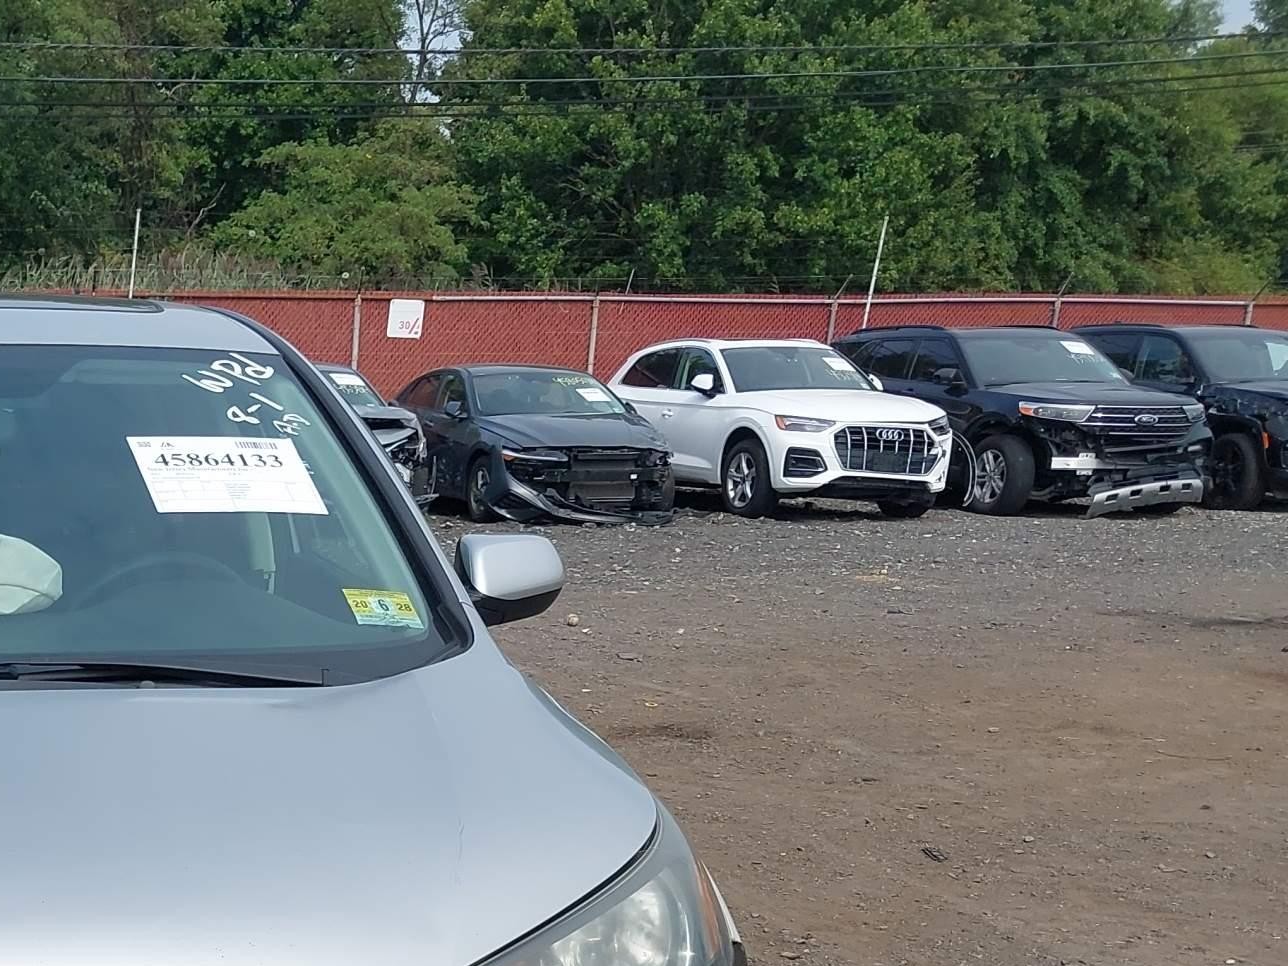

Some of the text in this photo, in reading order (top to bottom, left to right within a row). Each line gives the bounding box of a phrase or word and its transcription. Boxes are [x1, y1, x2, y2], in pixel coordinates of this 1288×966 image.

[154, 453, 283, 468] 45864133
[352, 599, 412, 612] 20 6 28
